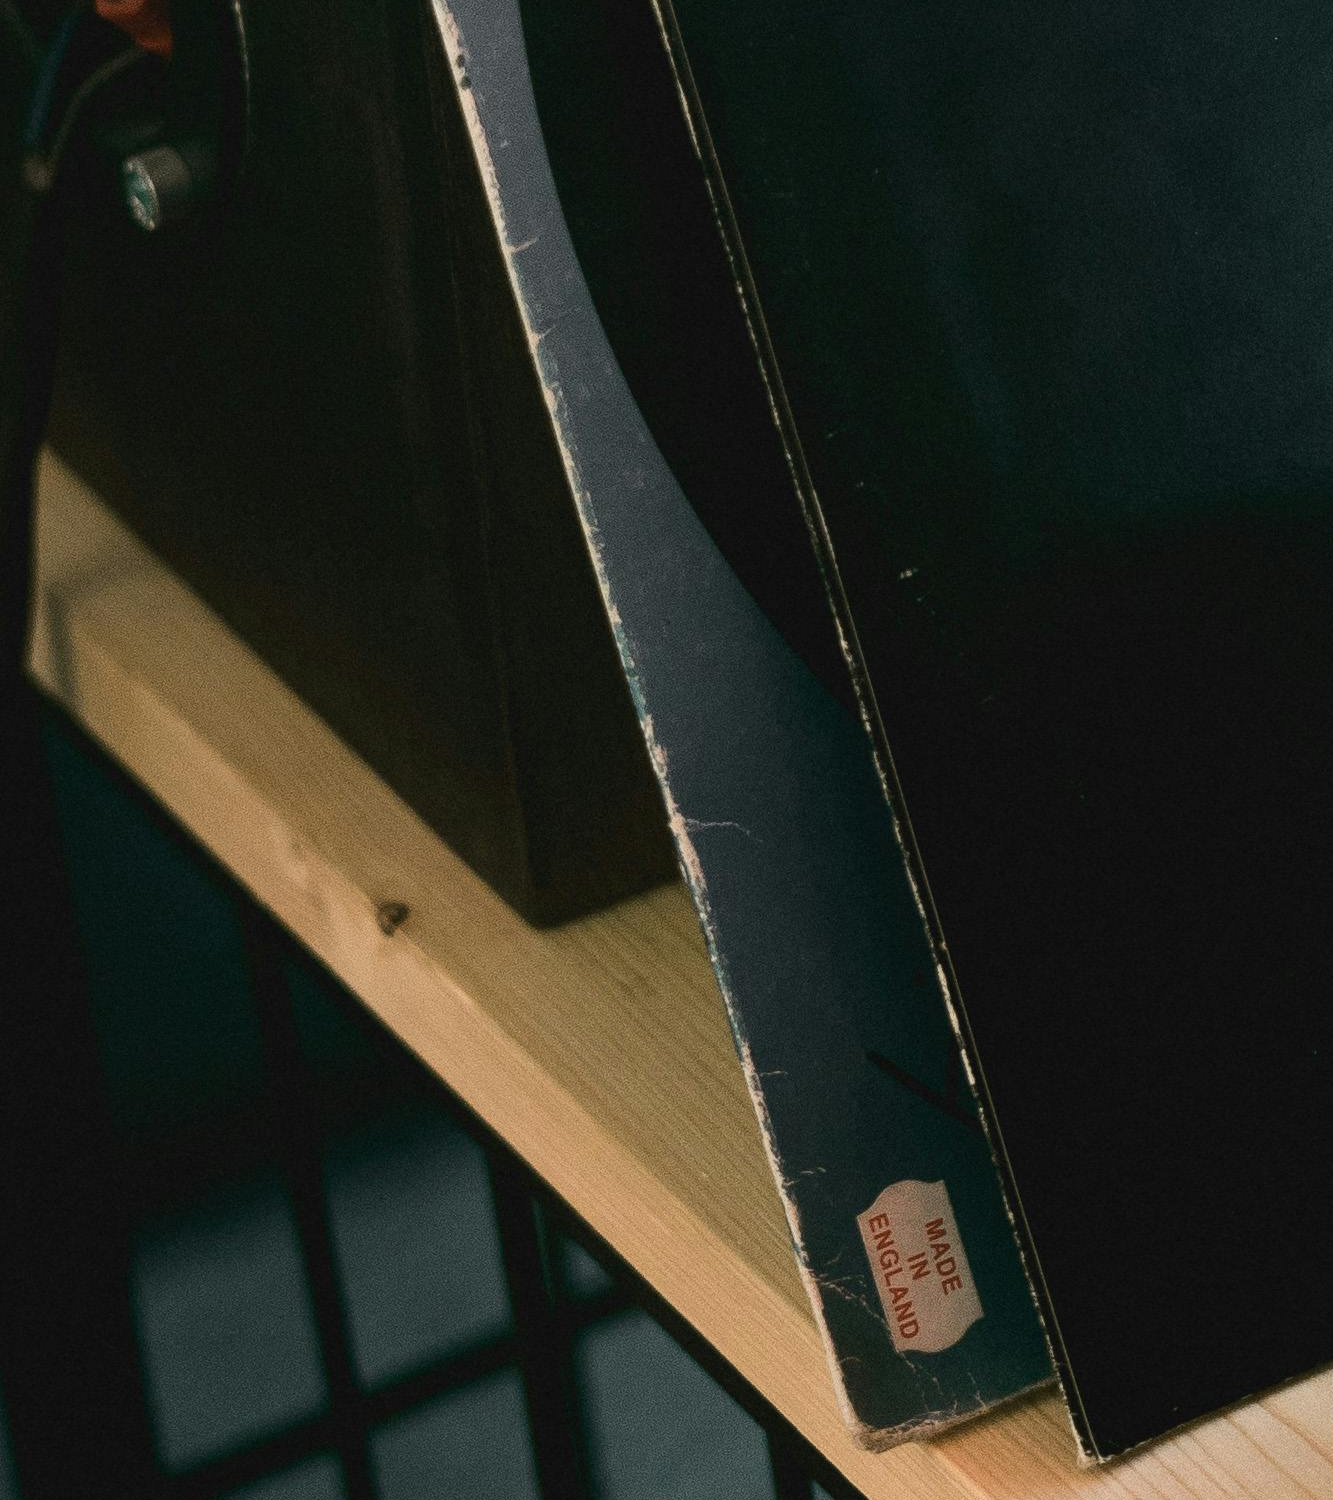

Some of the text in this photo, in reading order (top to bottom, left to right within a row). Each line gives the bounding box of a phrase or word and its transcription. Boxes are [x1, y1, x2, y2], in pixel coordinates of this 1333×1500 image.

[867, 1212, 920, 1340] ENGLAND
[906, 1251, 931, 1281] IN
[924, 1217, 964, 1295] MADE
